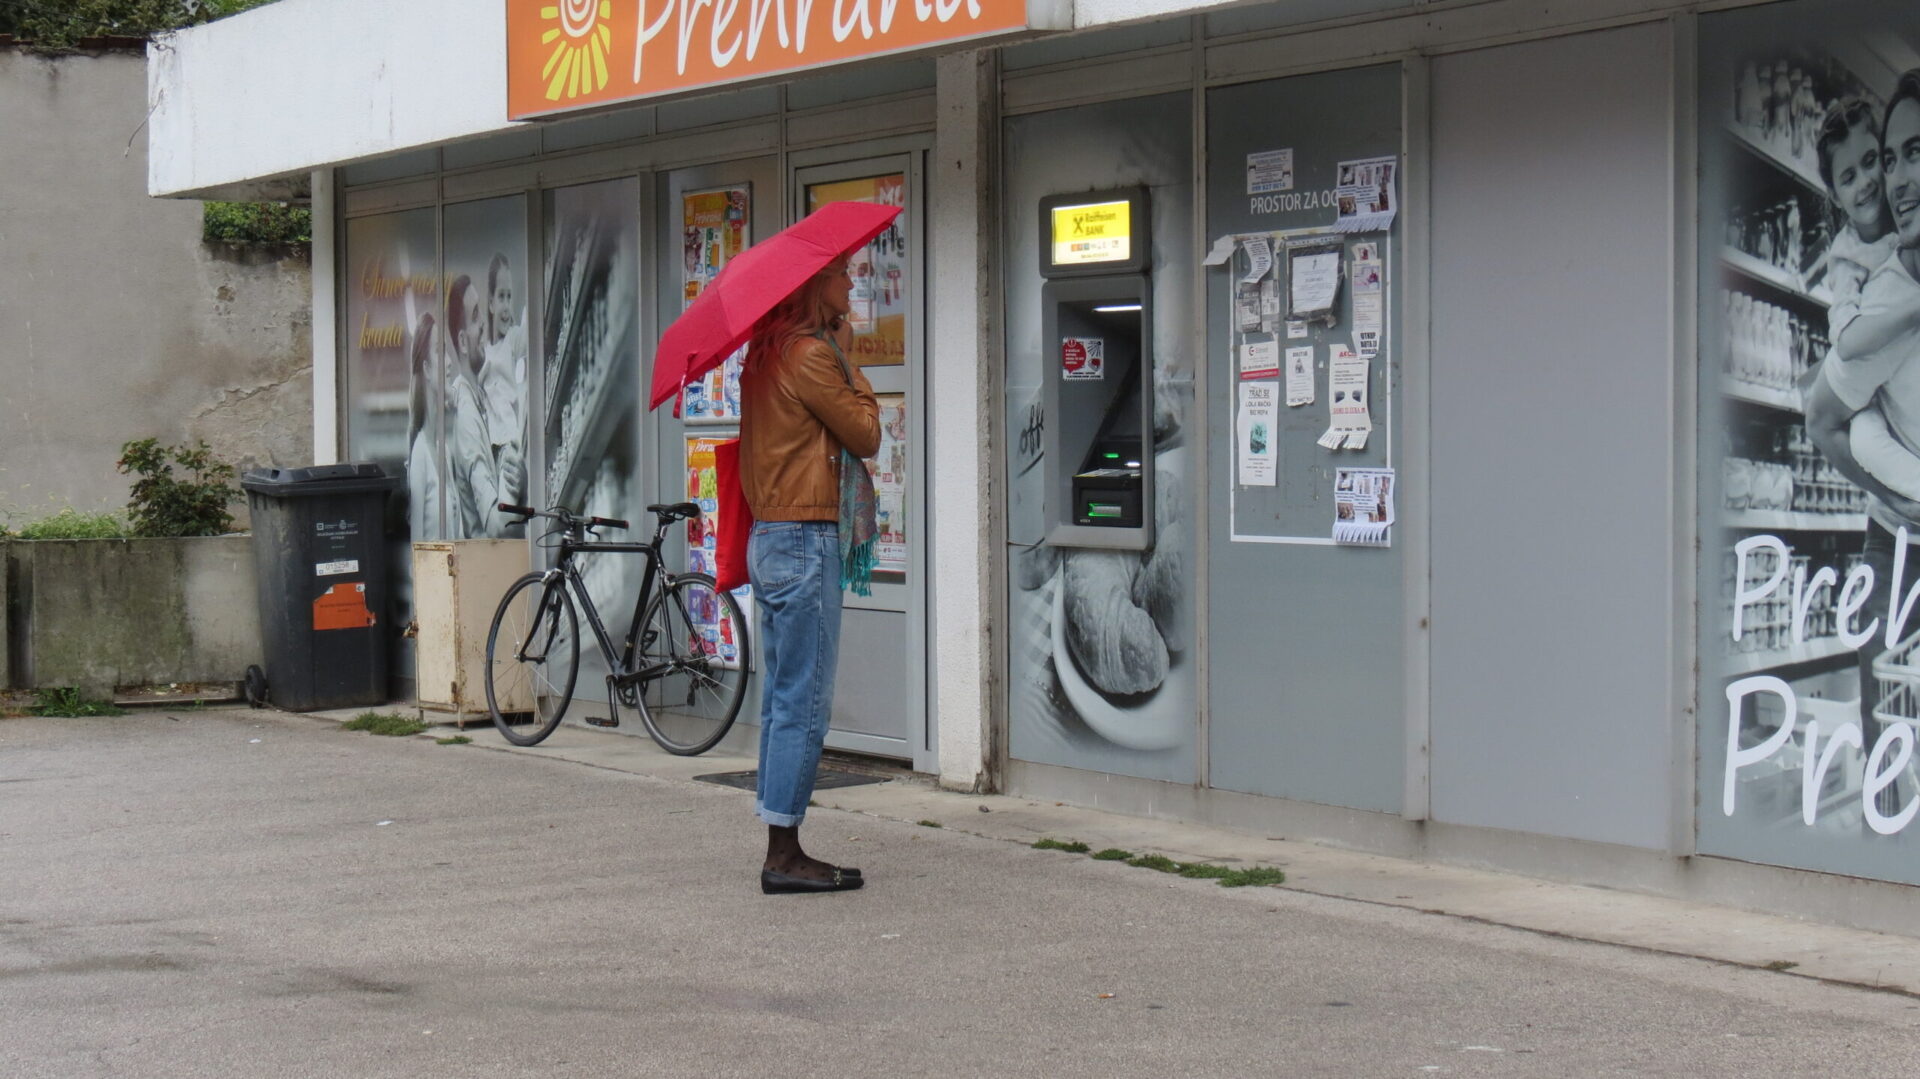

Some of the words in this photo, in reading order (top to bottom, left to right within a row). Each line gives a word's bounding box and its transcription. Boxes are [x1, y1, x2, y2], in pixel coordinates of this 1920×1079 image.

[1251, 193, 1301, 214] PROSTOR
[1304, 192, 1319, 210] ZA
[1086, 225, 1104, 236] BANK
[1723, 676, 1920, 835] Pre
